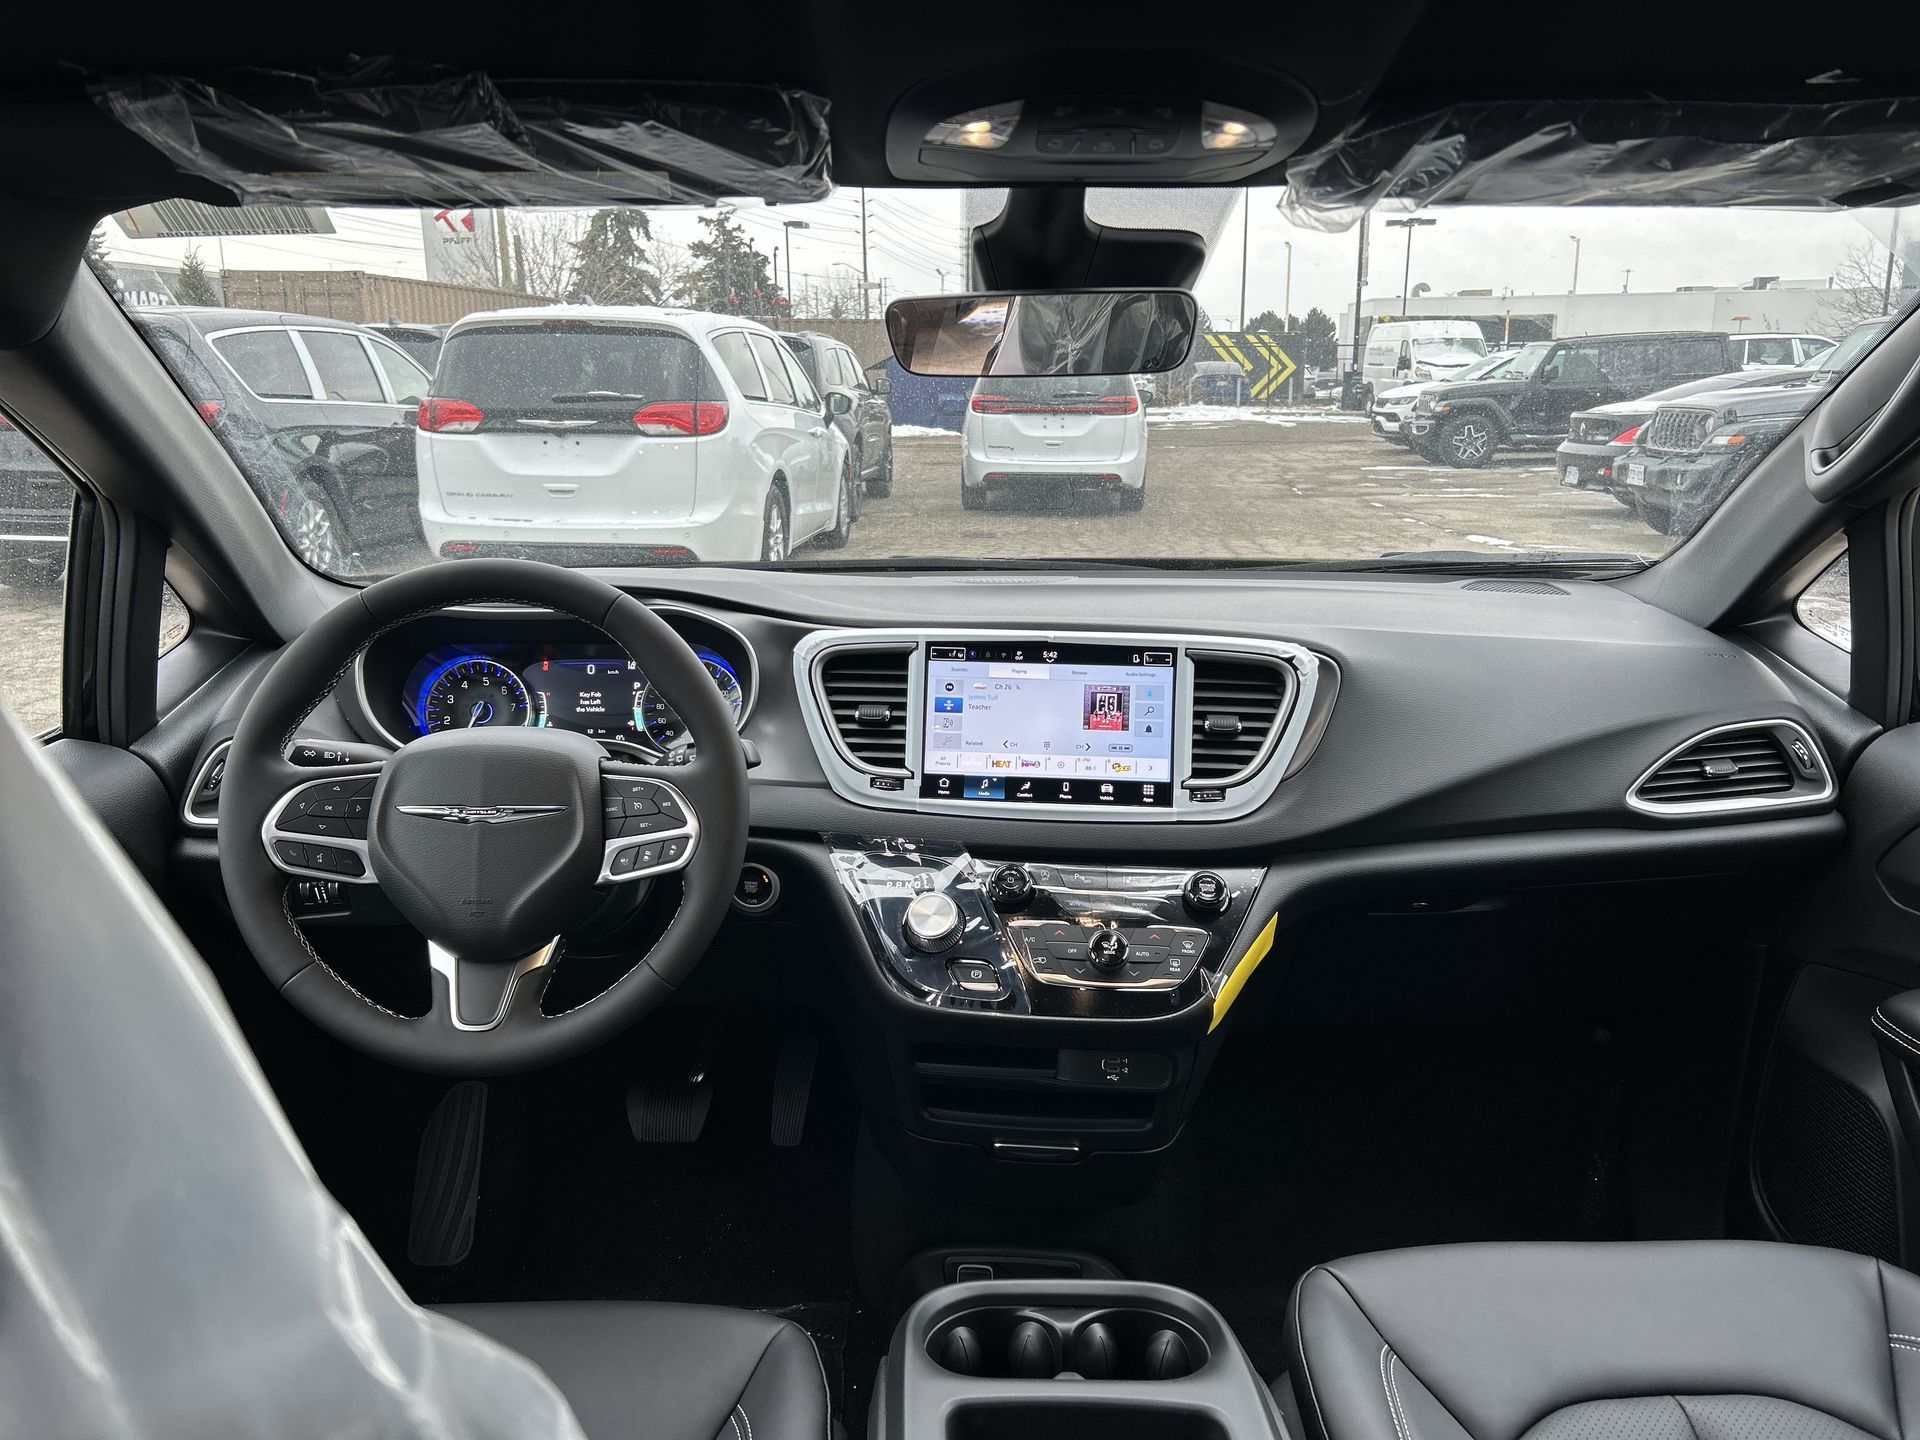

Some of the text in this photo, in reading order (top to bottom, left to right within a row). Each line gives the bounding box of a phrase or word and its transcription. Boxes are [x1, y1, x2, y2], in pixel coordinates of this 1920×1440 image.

[1042, 651, 1058, 659] 5:42
[587, 664, 595, 674] 0
[461, 680, 469, 690] 4
[482, 677, 490, 686] 5
[633, 681, 641, 690] P
[501, 686, 509, 695] 6
[447, 694, 454, 704] 3
[511, 703, 516, 712] 7
[968, 703, 992, 711] Teacher
[443, 715, 451, 725] 2
[991, 760, 1012, 769] HEAT
